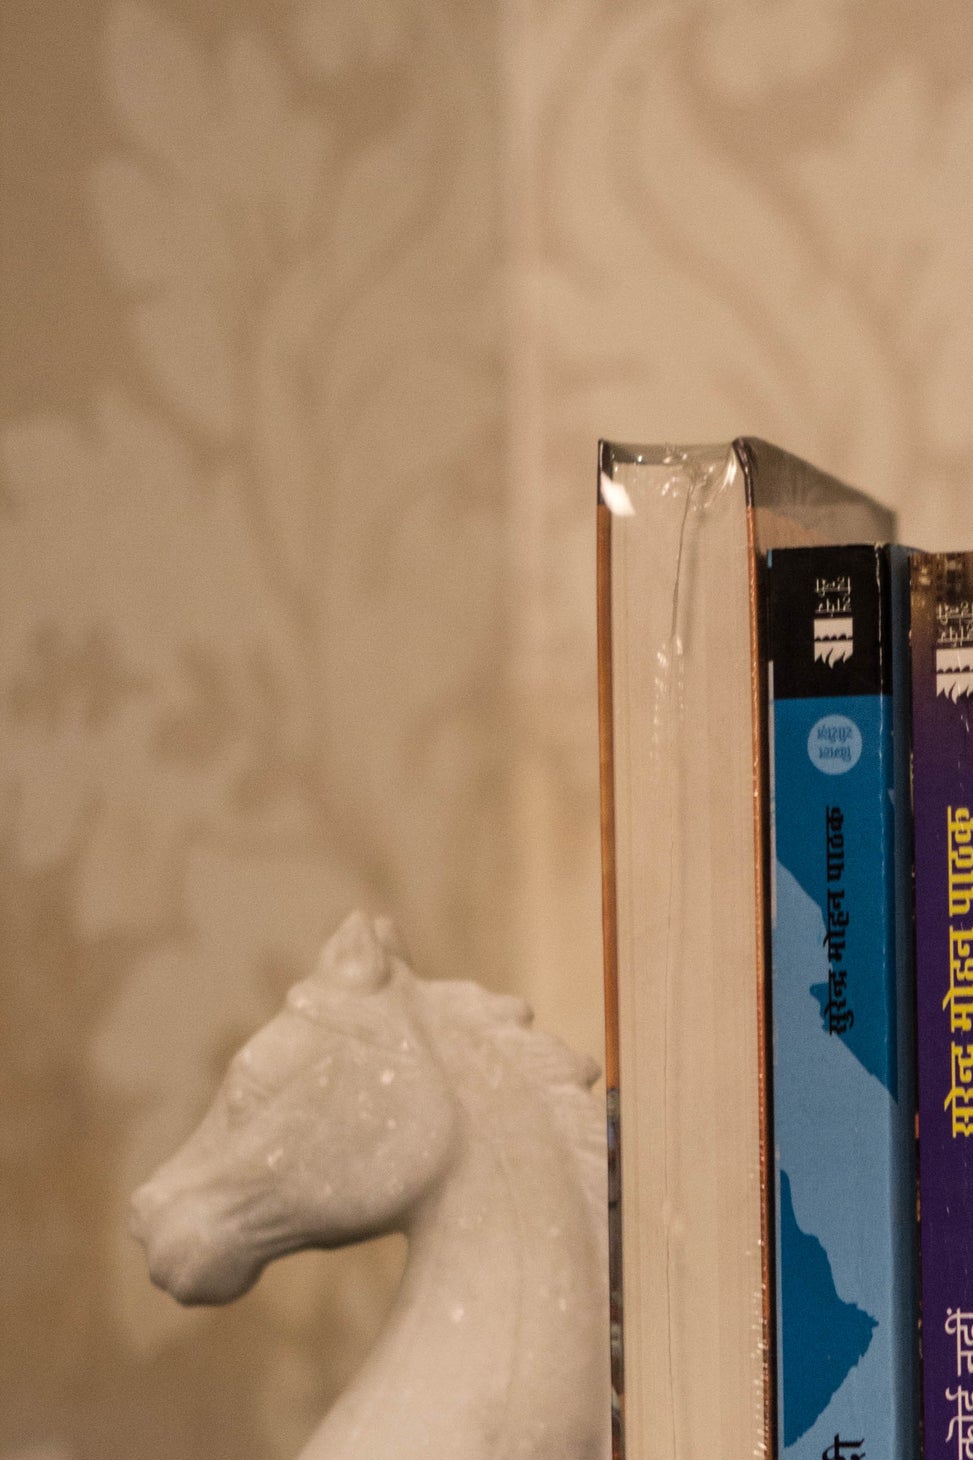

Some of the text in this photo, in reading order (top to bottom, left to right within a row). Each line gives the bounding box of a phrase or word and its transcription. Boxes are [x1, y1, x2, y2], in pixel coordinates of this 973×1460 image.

[822, 806, 854, 1035] सुरेन्द्र मोहन पाठक
